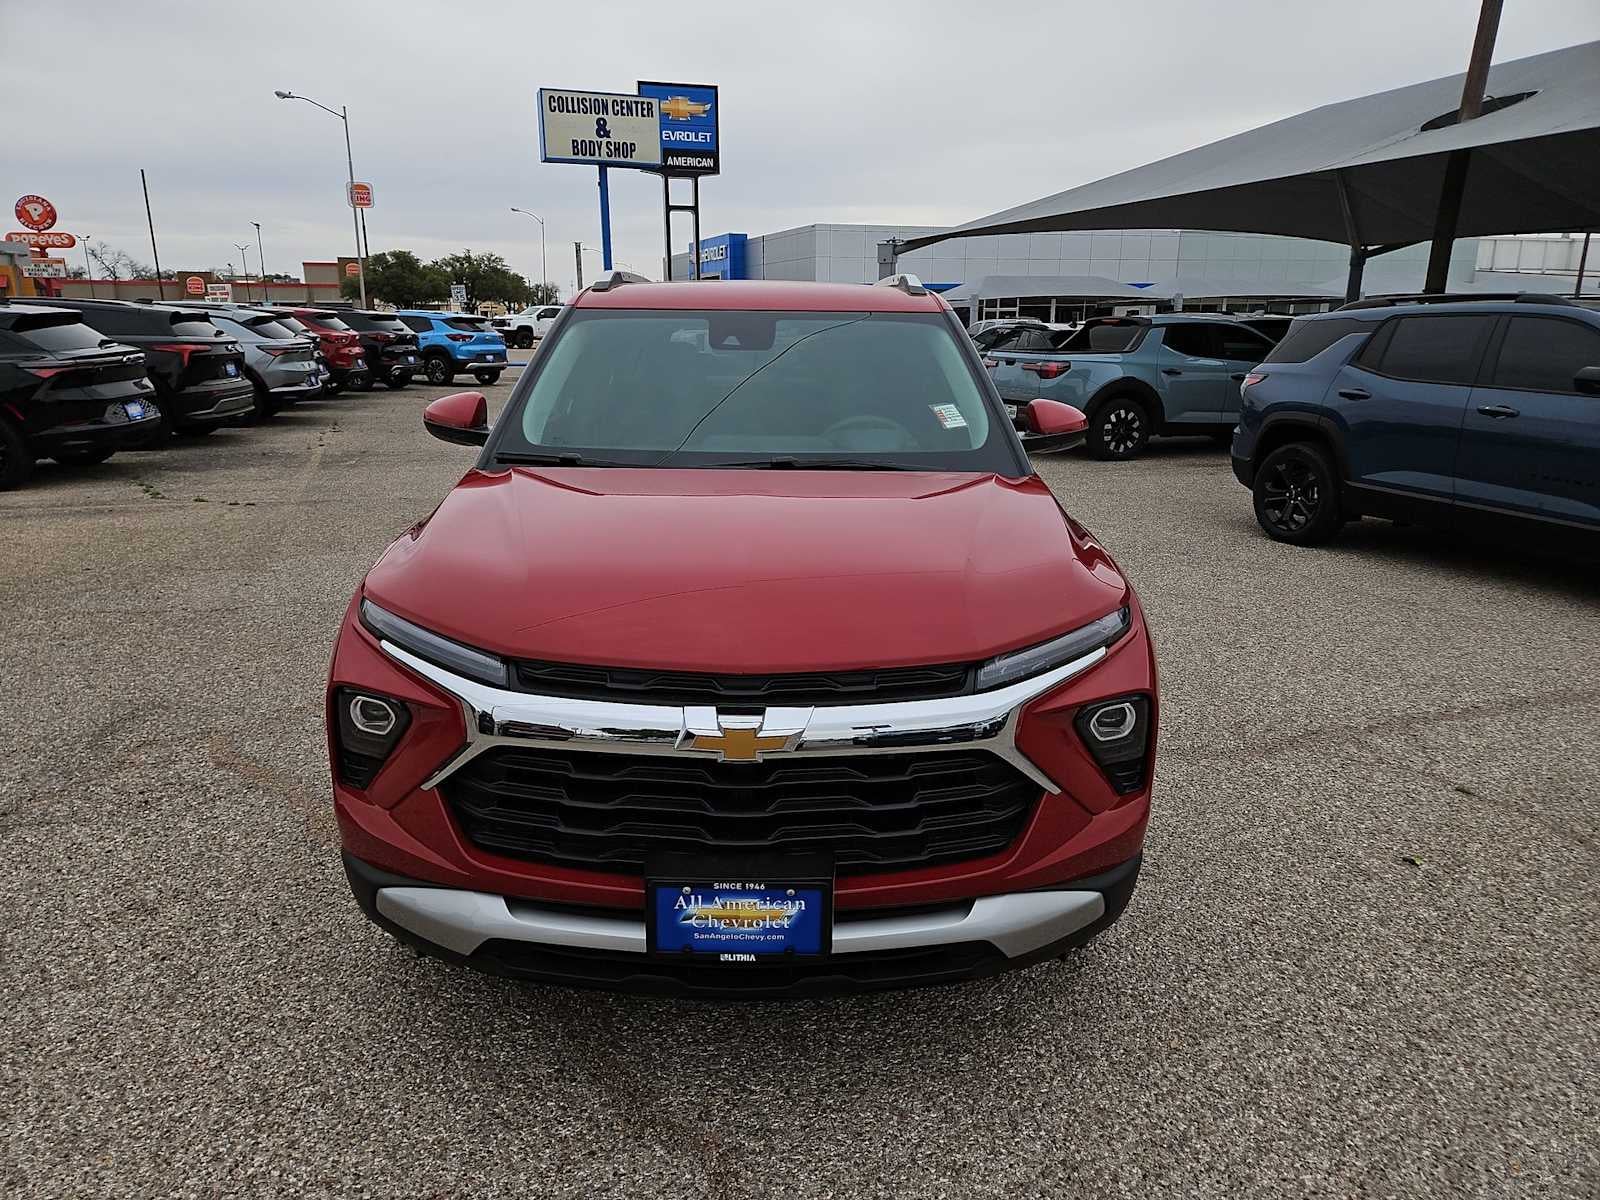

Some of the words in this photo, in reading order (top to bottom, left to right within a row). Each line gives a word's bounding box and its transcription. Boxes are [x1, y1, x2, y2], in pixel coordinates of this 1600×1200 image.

[548, 95, 609, 115] COLLISION
[611, 99, 654, 118] CENTER
[595, 117, 611, 138] &
[662, 130, 712, 142] EVROLET
[571, 139, 602, 157] BODY
[605, 141, 636, 158] SHOP
[667, 156, 714, 168] AMERICAN
[745, 883, 765, 891] 1946
[674, 895, 703, 910] All
[712, 896, 806, 911] American
[692, 914, 790, 929] Chevrolet
[694, 932, 785, 942] SanAngeloChevy.com
[729, 954, 756, 962] LITHIA
